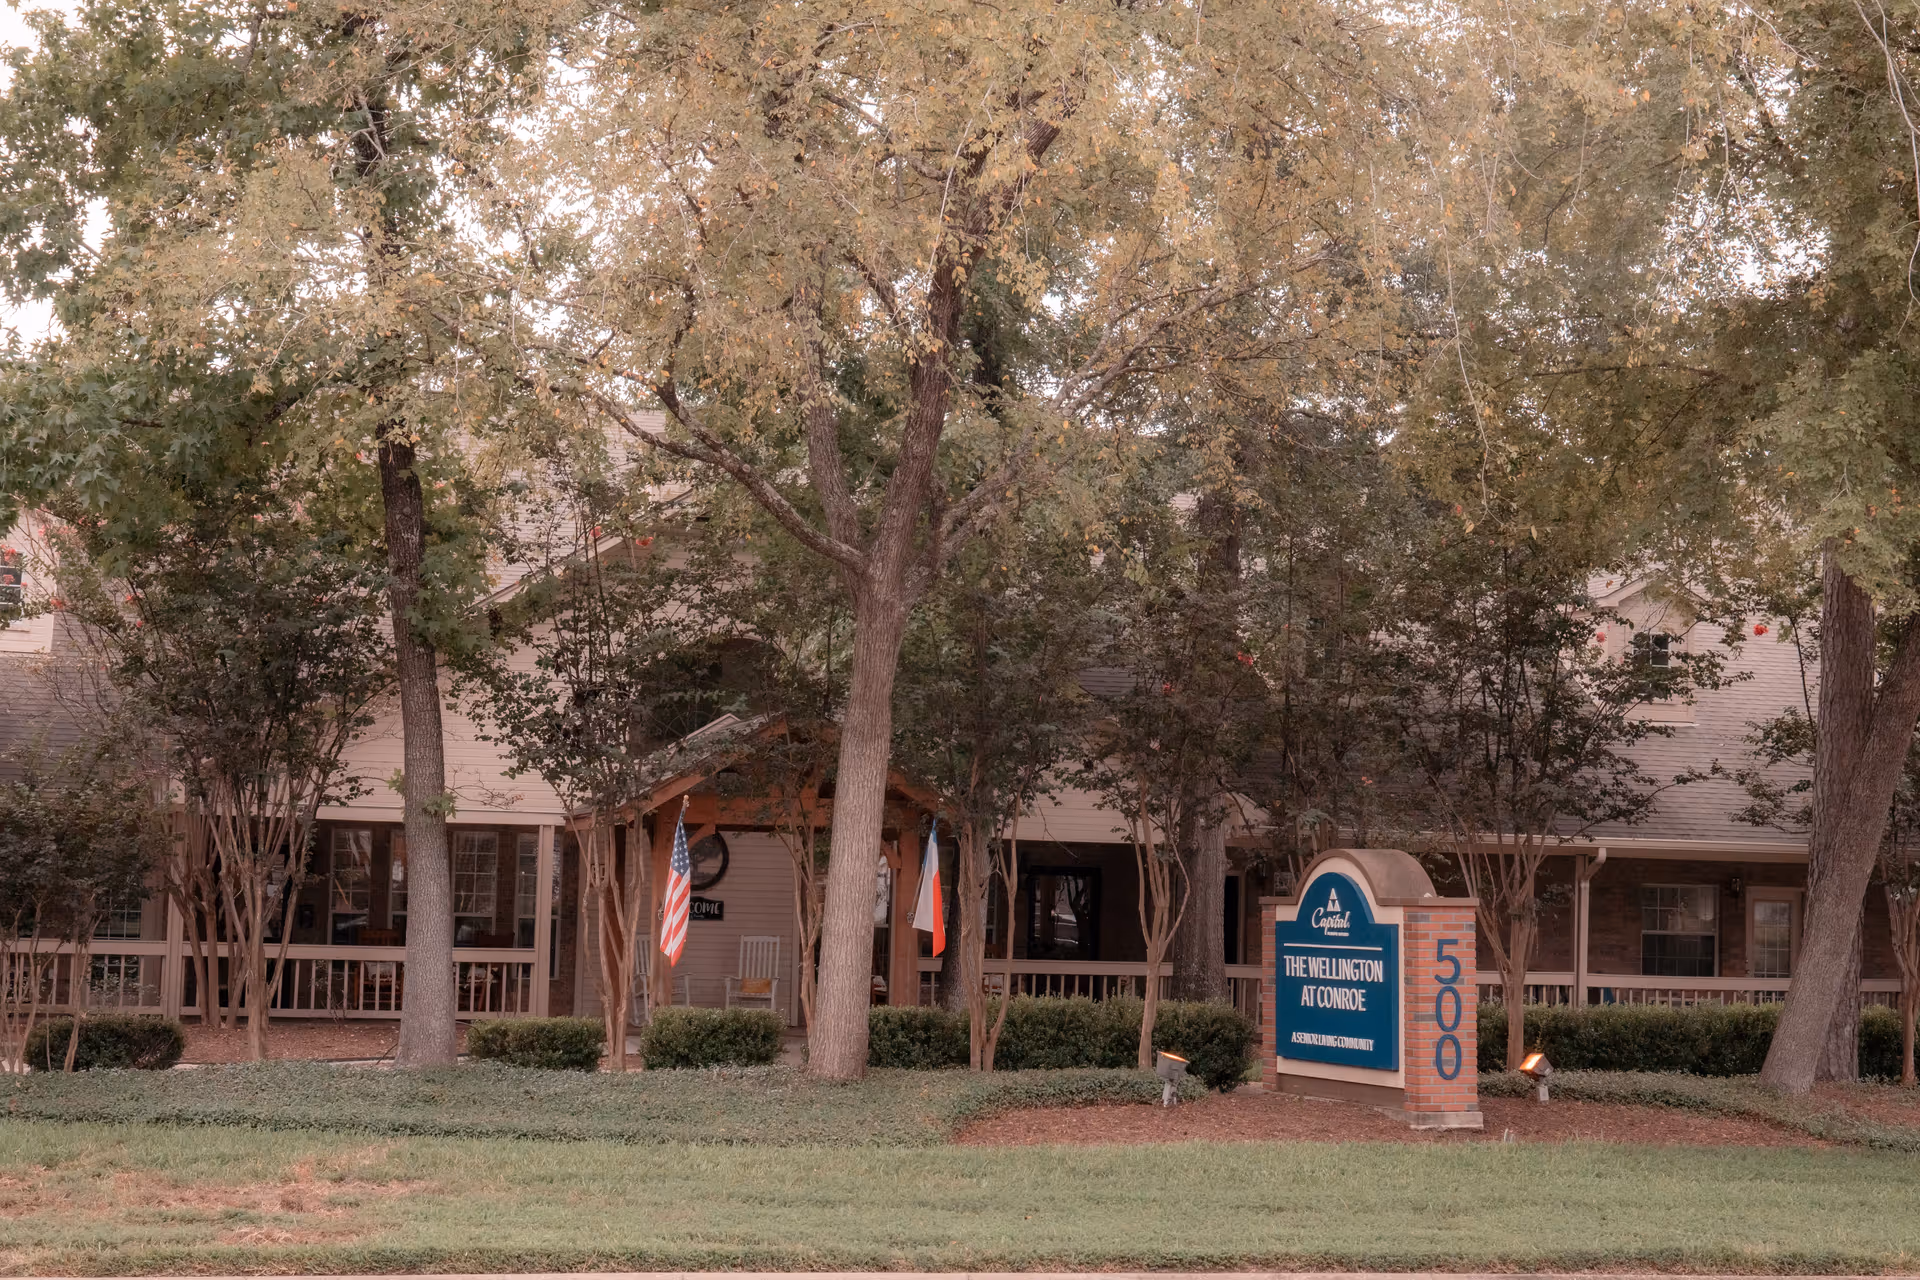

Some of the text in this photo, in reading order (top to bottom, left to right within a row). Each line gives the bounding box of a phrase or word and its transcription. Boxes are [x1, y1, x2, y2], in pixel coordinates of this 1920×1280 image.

[690, 902, 721, 915] COME
[1312, 907, 1350, 936] Capital
[1284, 955, 1383, 983] THE WELLINGTON
[1301, 985, 1366, 1011] AT CONROE
[1434, 939, 1462, 1081] 500
[1291, 1032, 1374, 1051] A SENIOR LIVING COMMUNITY
